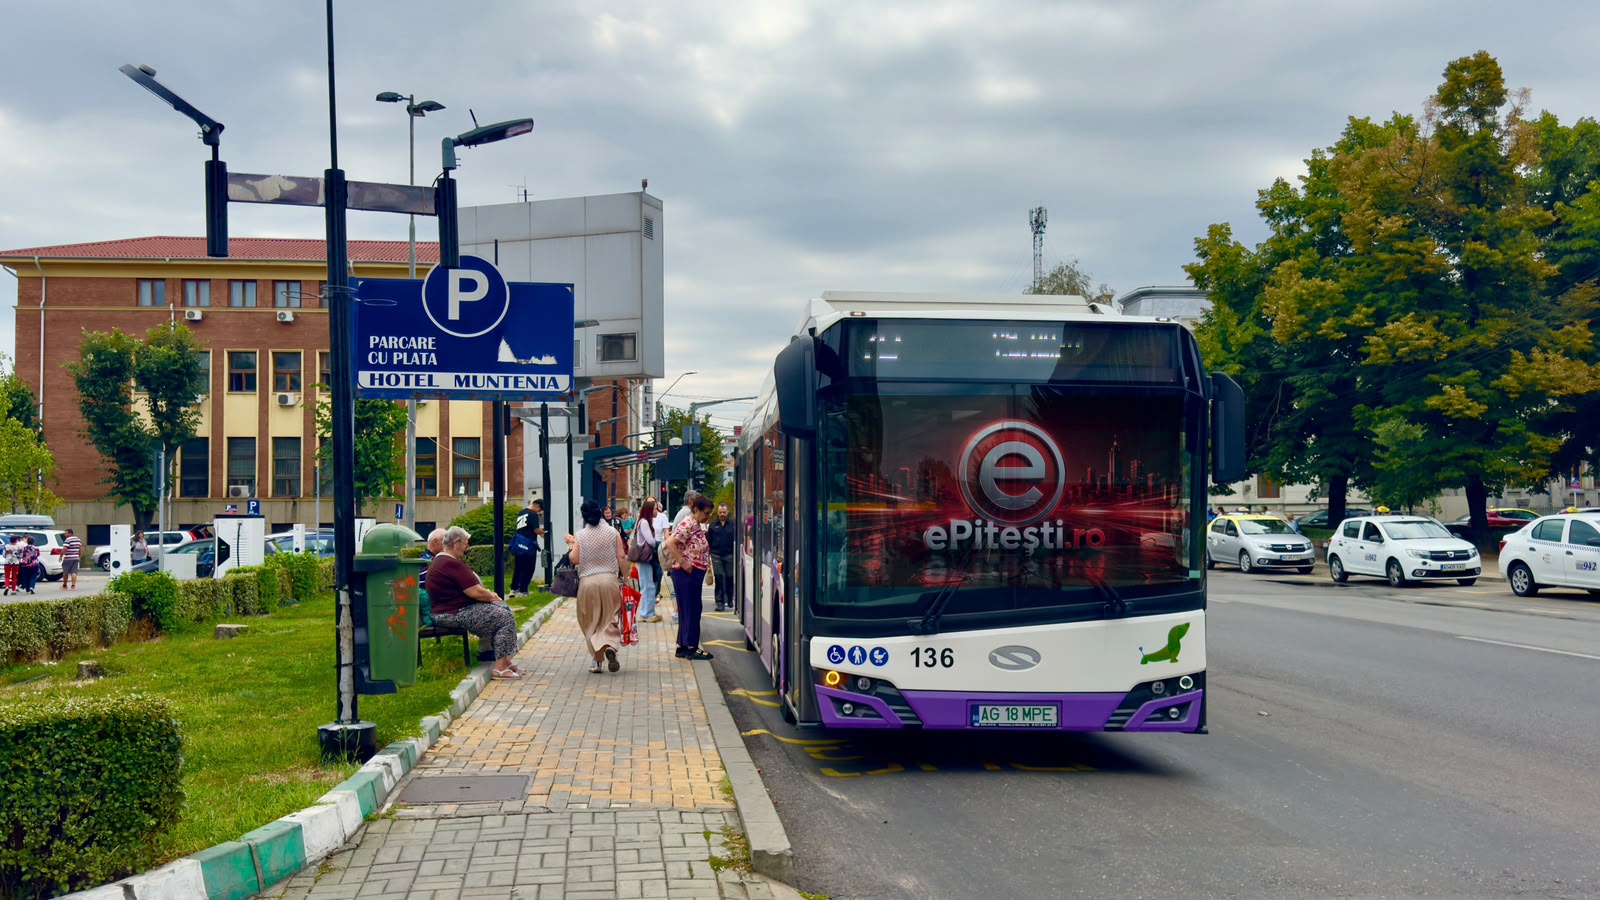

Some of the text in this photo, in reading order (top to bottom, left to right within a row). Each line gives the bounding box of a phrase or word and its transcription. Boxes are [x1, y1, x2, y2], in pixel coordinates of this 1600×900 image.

[448, 268, 489, 320] P
[369, 335, 436, 350] PARCARE
[368, 351, 437, 365] CU PLATA
[369, 373, 560, 390] HOTEL MUNTENIA
[250, 501, 256, 510] P
[1583, 561, 1597, 571] 942
[910, 646, 954, 668] 136
[981, 707, 1000, 721] AG
[1005, 707, 1019, 721] 18
[1022, 707, 1053, 721] MPE
